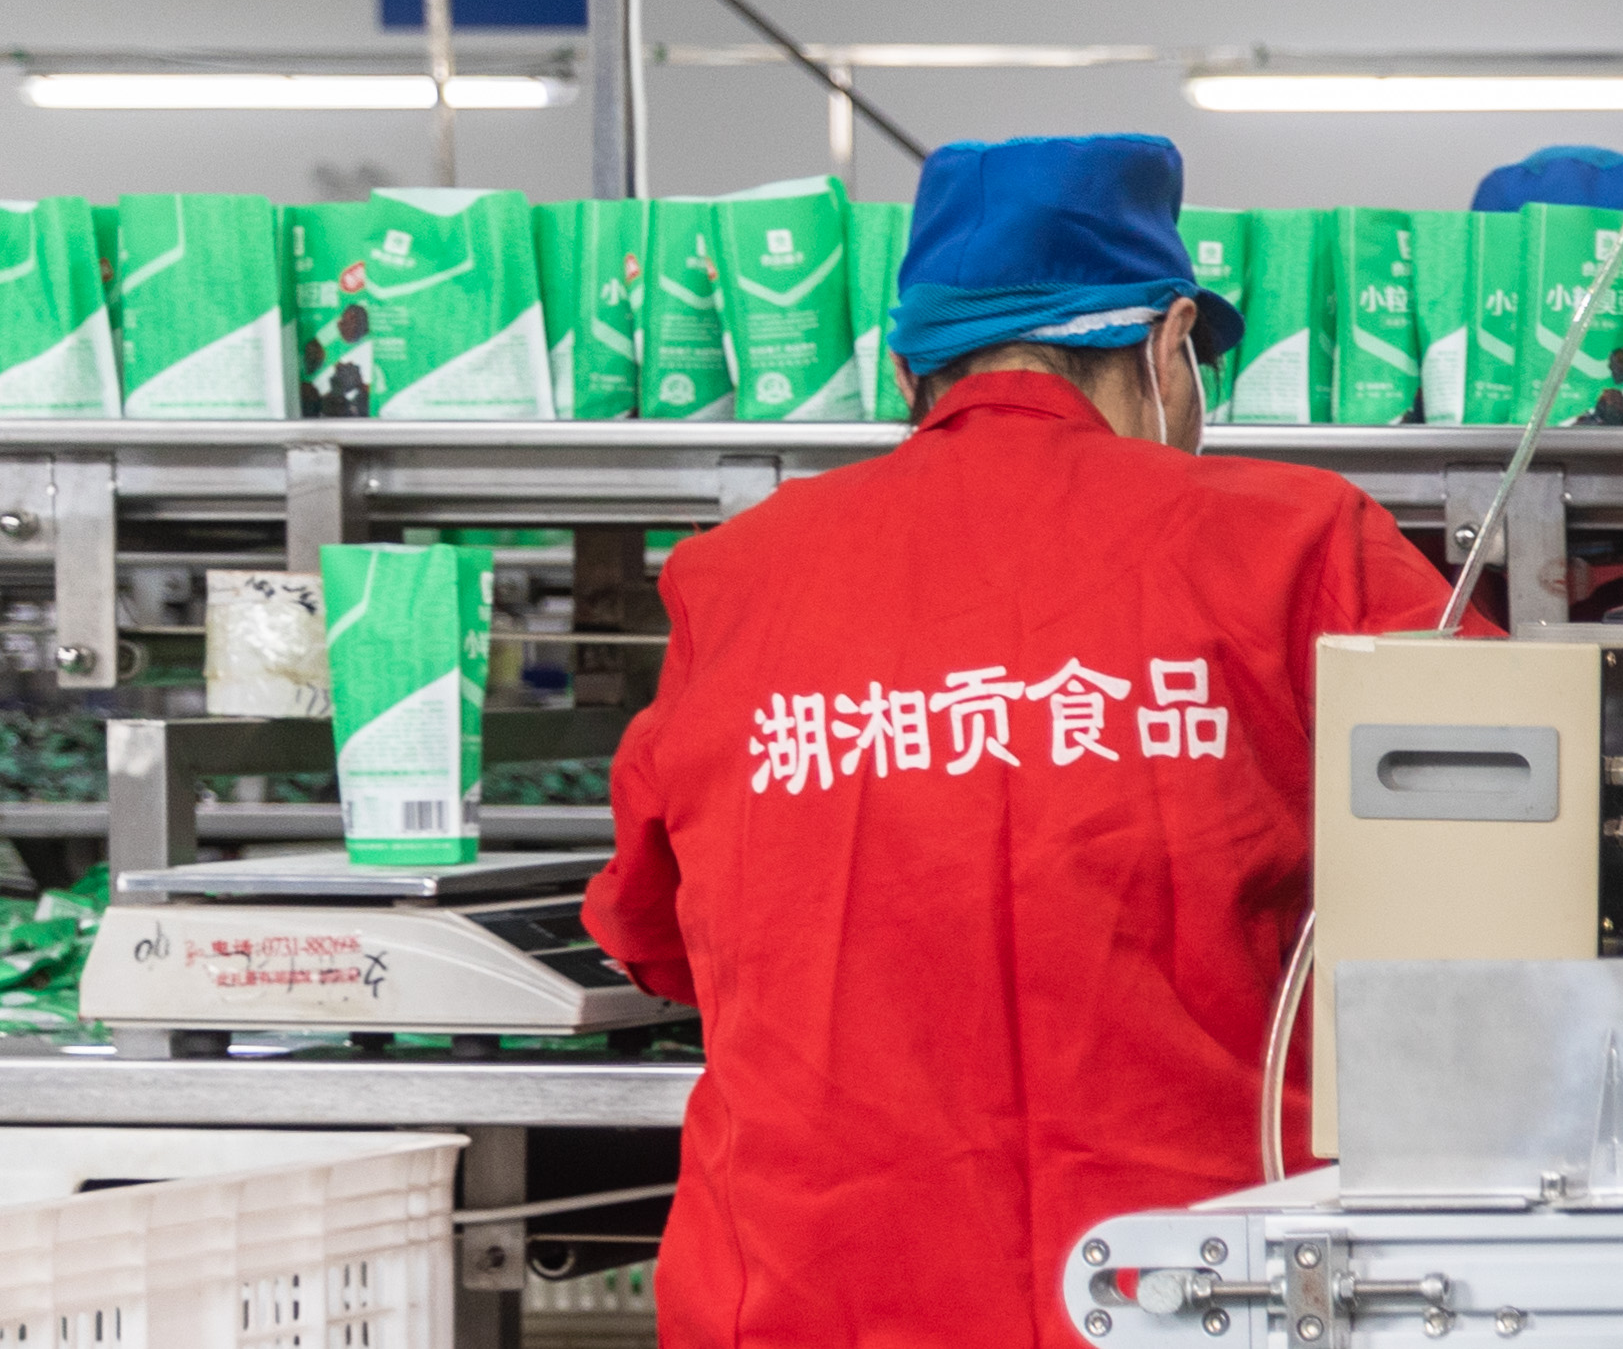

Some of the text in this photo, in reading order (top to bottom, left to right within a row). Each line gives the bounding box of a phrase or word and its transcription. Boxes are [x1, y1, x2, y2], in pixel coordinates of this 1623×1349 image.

[749, 657, 1229, 794] 湖湘贡食品
